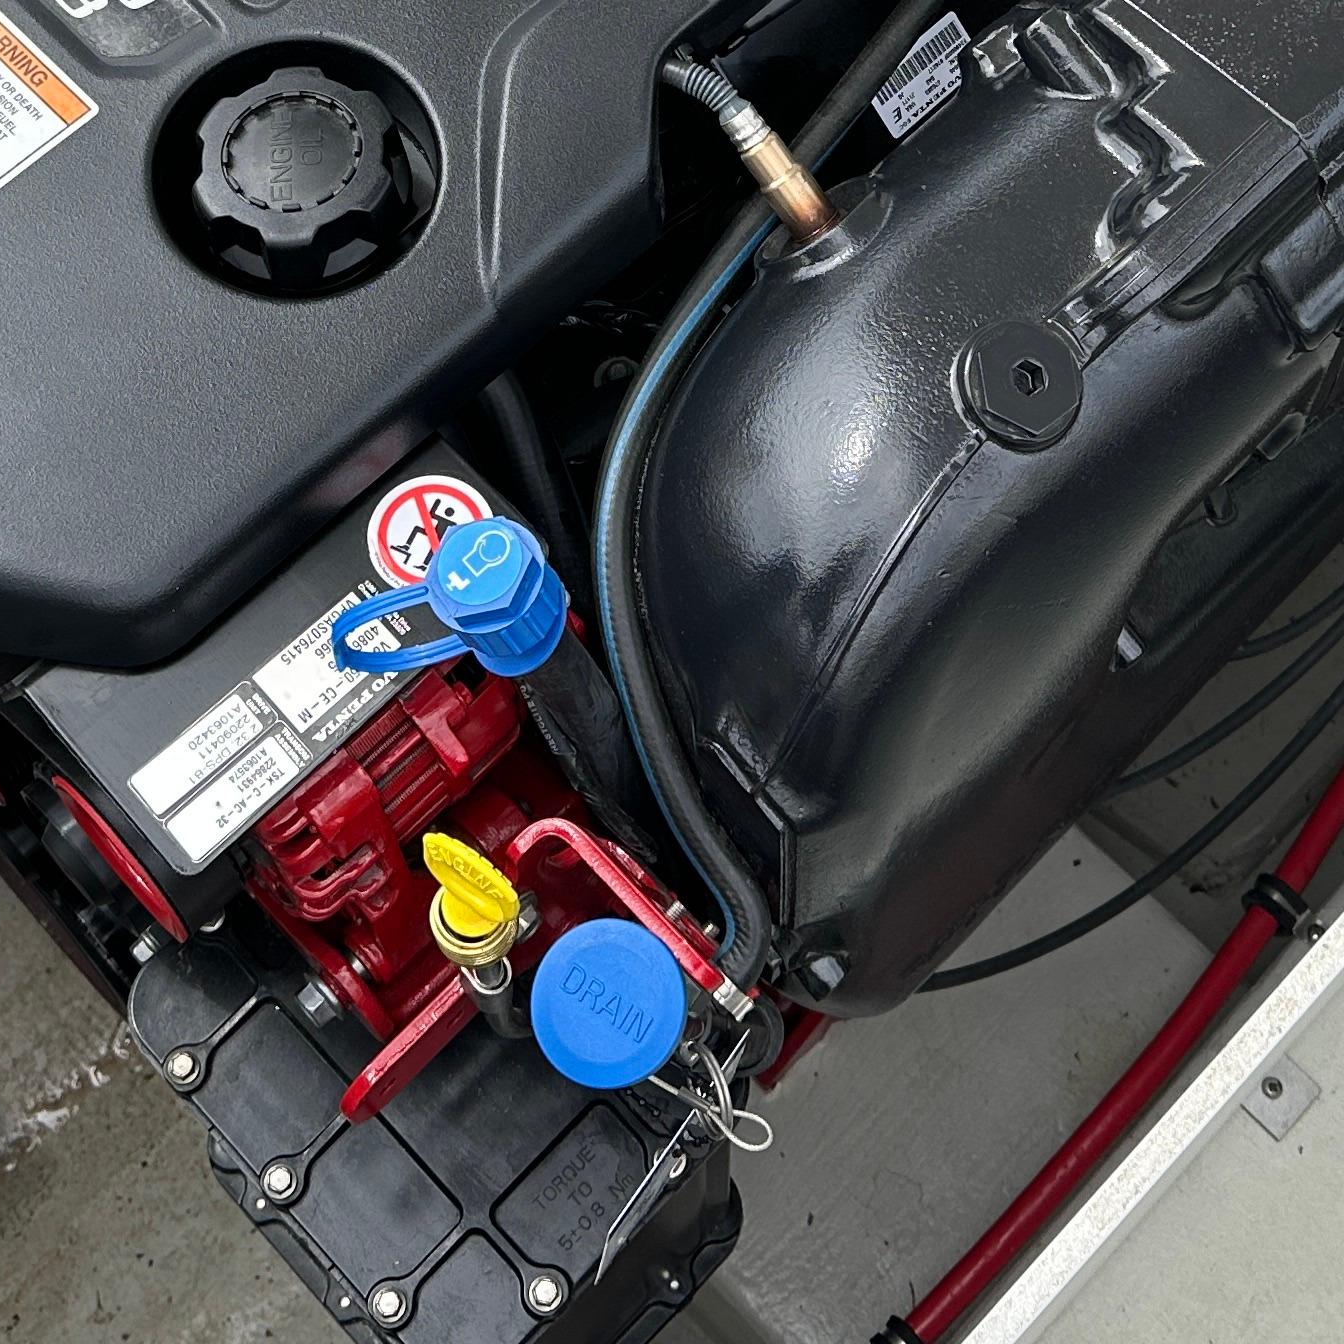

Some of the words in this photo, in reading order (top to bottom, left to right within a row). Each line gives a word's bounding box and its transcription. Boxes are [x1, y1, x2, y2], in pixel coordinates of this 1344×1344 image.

[0, 79, 17, 97] OR
[11, 91, 43, 122] DEATH
[186, 701, 243, 751] A1063420
[196, 711, 252, 760] 22090411
[310, 688, 373, 744] PENTA
[226, 746, 269, 784] A1063574
[558, 961, 655, 1044] DRAIN
[531, 1144, 597, 1211] TORQUE
[565, 1179, 594, 1208] TO
[606, 1172, 634, 1198] Nm
